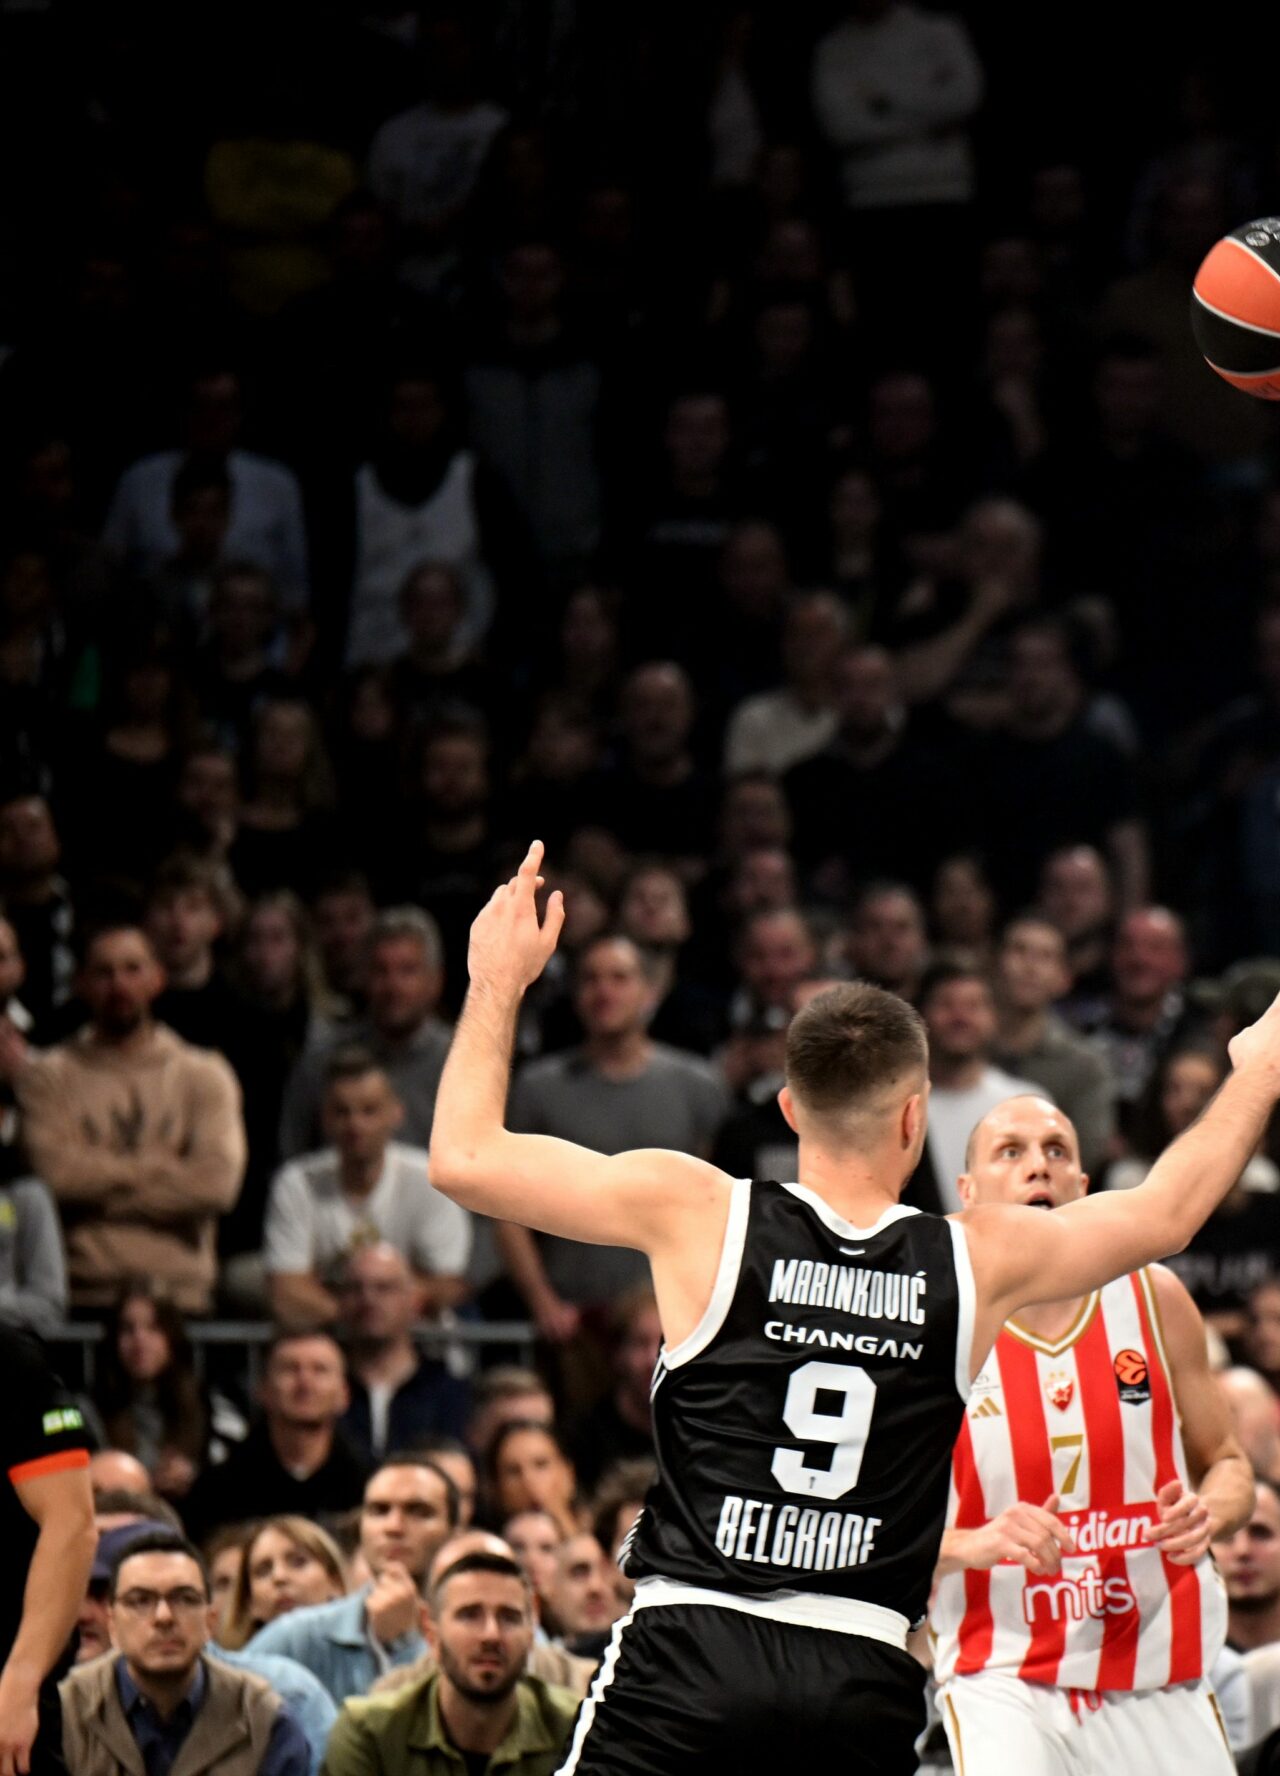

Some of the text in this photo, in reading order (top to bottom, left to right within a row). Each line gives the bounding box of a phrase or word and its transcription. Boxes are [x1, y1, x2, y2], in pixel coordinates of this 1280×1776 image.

[768, 1259, 927, 1326] MARINKOVIĆ
[764, 1320, 925, 1360] CHANGAN
[770, 1360, 877, 1500] 9
[1050, 1433, 1084, 1495] 7
[1024, 1567, 1136, 1624] mts
